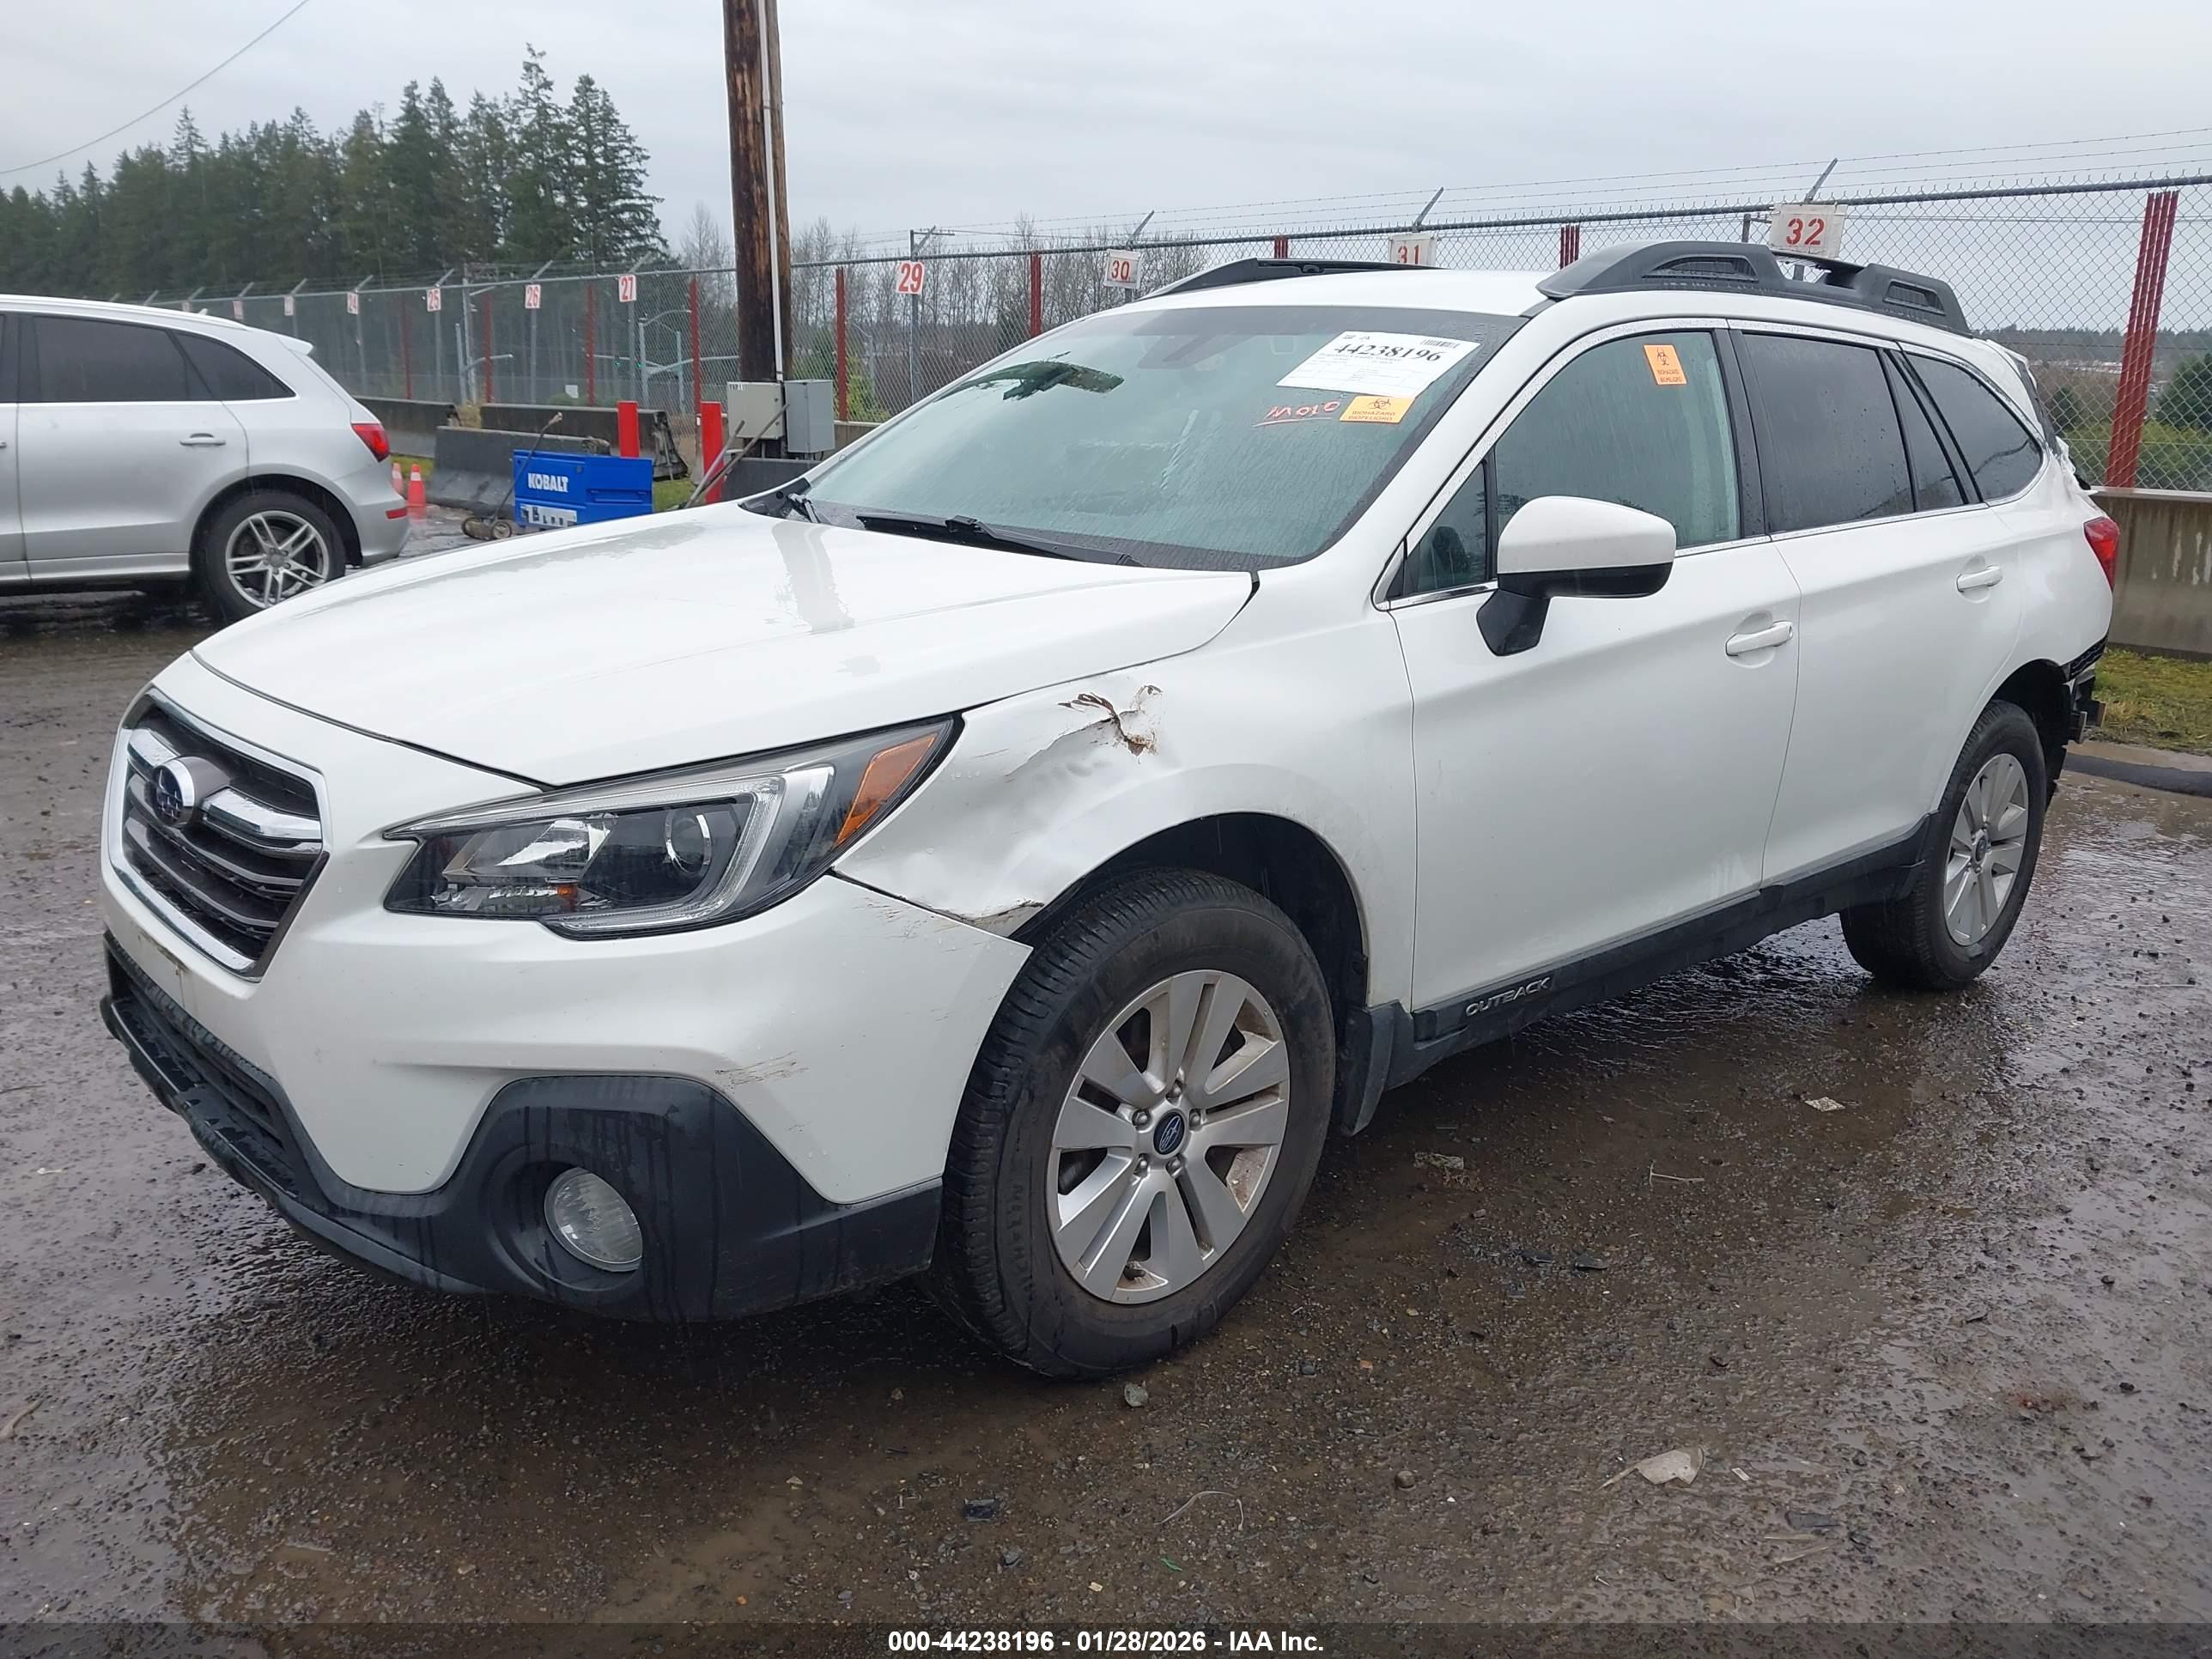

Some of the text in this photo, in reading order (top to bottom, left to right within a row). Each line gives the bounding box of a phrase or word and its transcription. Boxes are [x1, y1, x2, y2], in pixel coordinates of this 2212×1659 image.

[1785, 217, 1825, 246] 32
[1397, 244, 1419, 264] 31
[898, 262, 923, 293] 29
[1111, 260, 1130, 281] 30
[526, 286, 540, 307] 26
[621, 276, 635, 301] 27
[1334, 343, 1449, 362] 44238196
[527, 472, 568, 493] KOBALT
[1465, 976, 1552, 1017] OUTBACK
